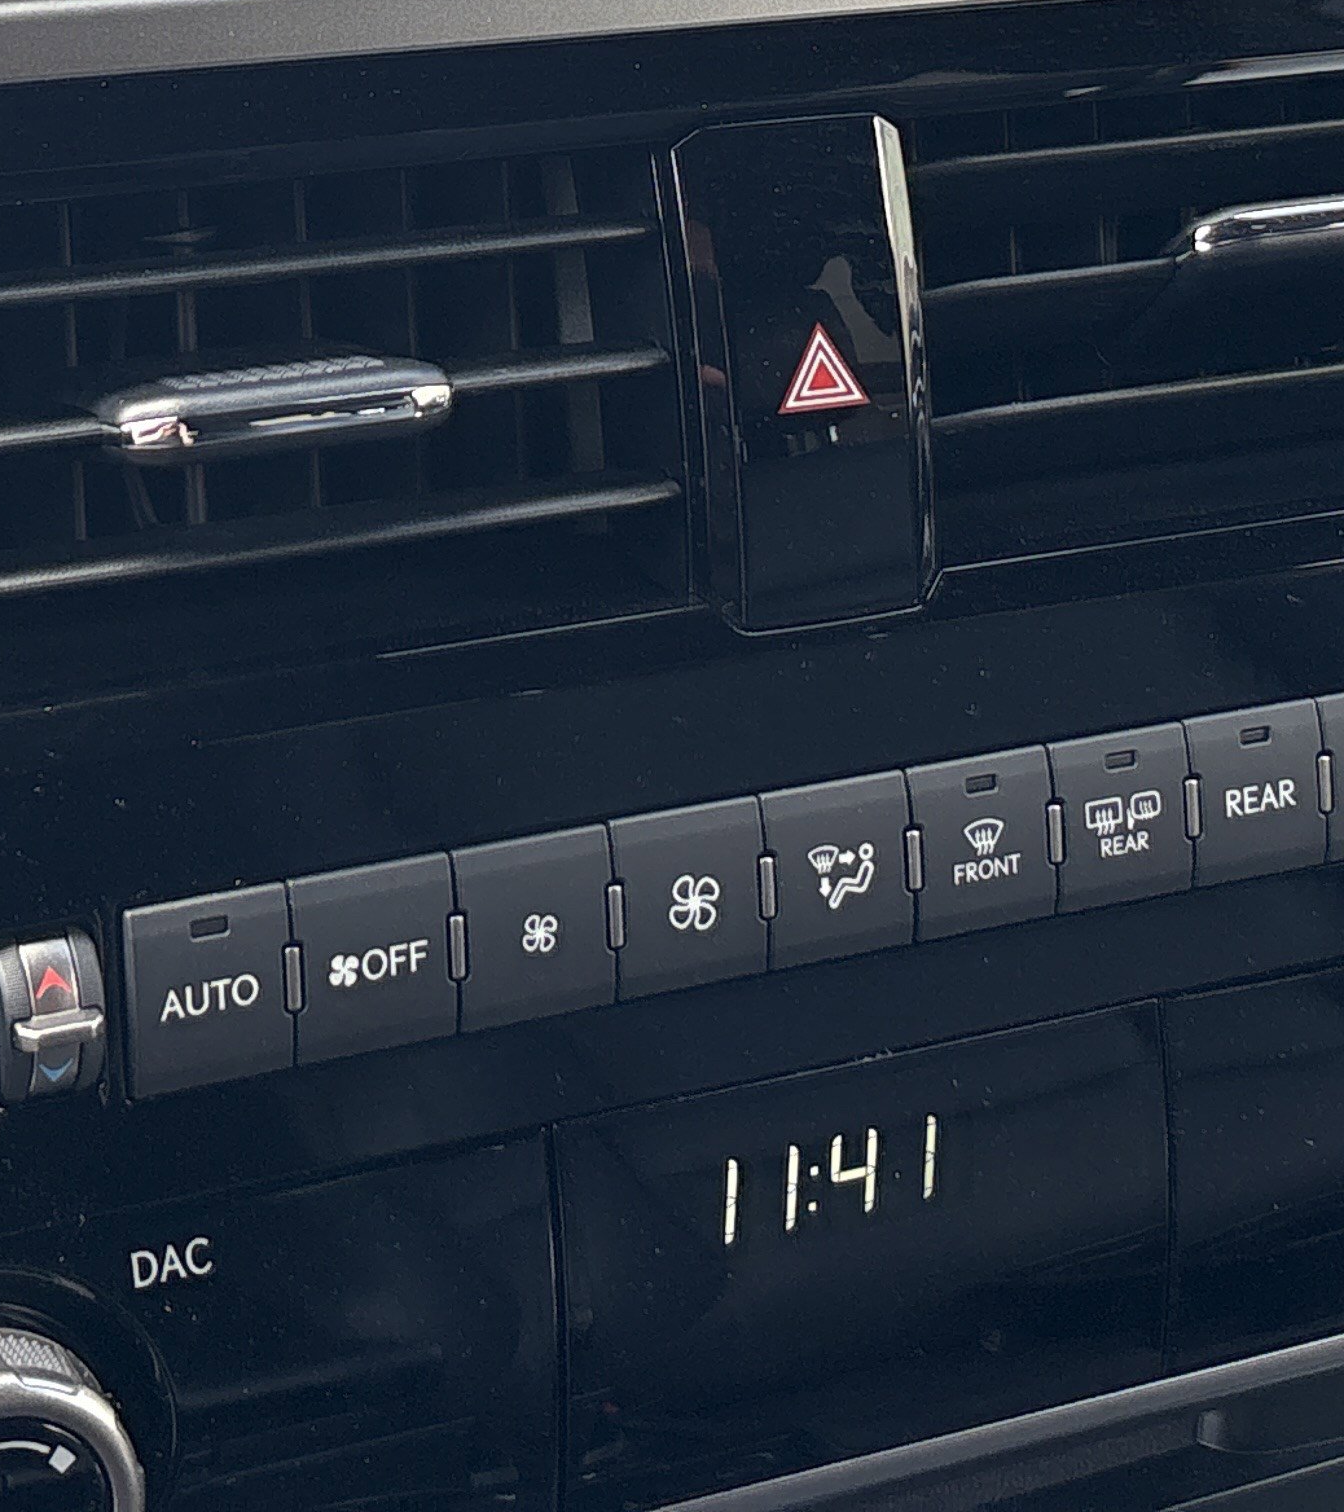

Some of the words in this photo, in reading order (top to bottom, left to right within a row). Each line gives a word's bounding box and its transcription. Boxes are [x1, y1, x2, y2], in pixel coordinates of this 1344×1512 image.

[1225, 779, 1297, 819] REAR
[1100, 831, 1150, 858] REAR
[953, 853, 1021, 886] FRONT
[362, 940, 429, 982] OFF
[159, 973, 260, 1022] AUTO
[724, 1112, 937, 1246] 11:41
[130, 1237, 214, 1289] DAC
